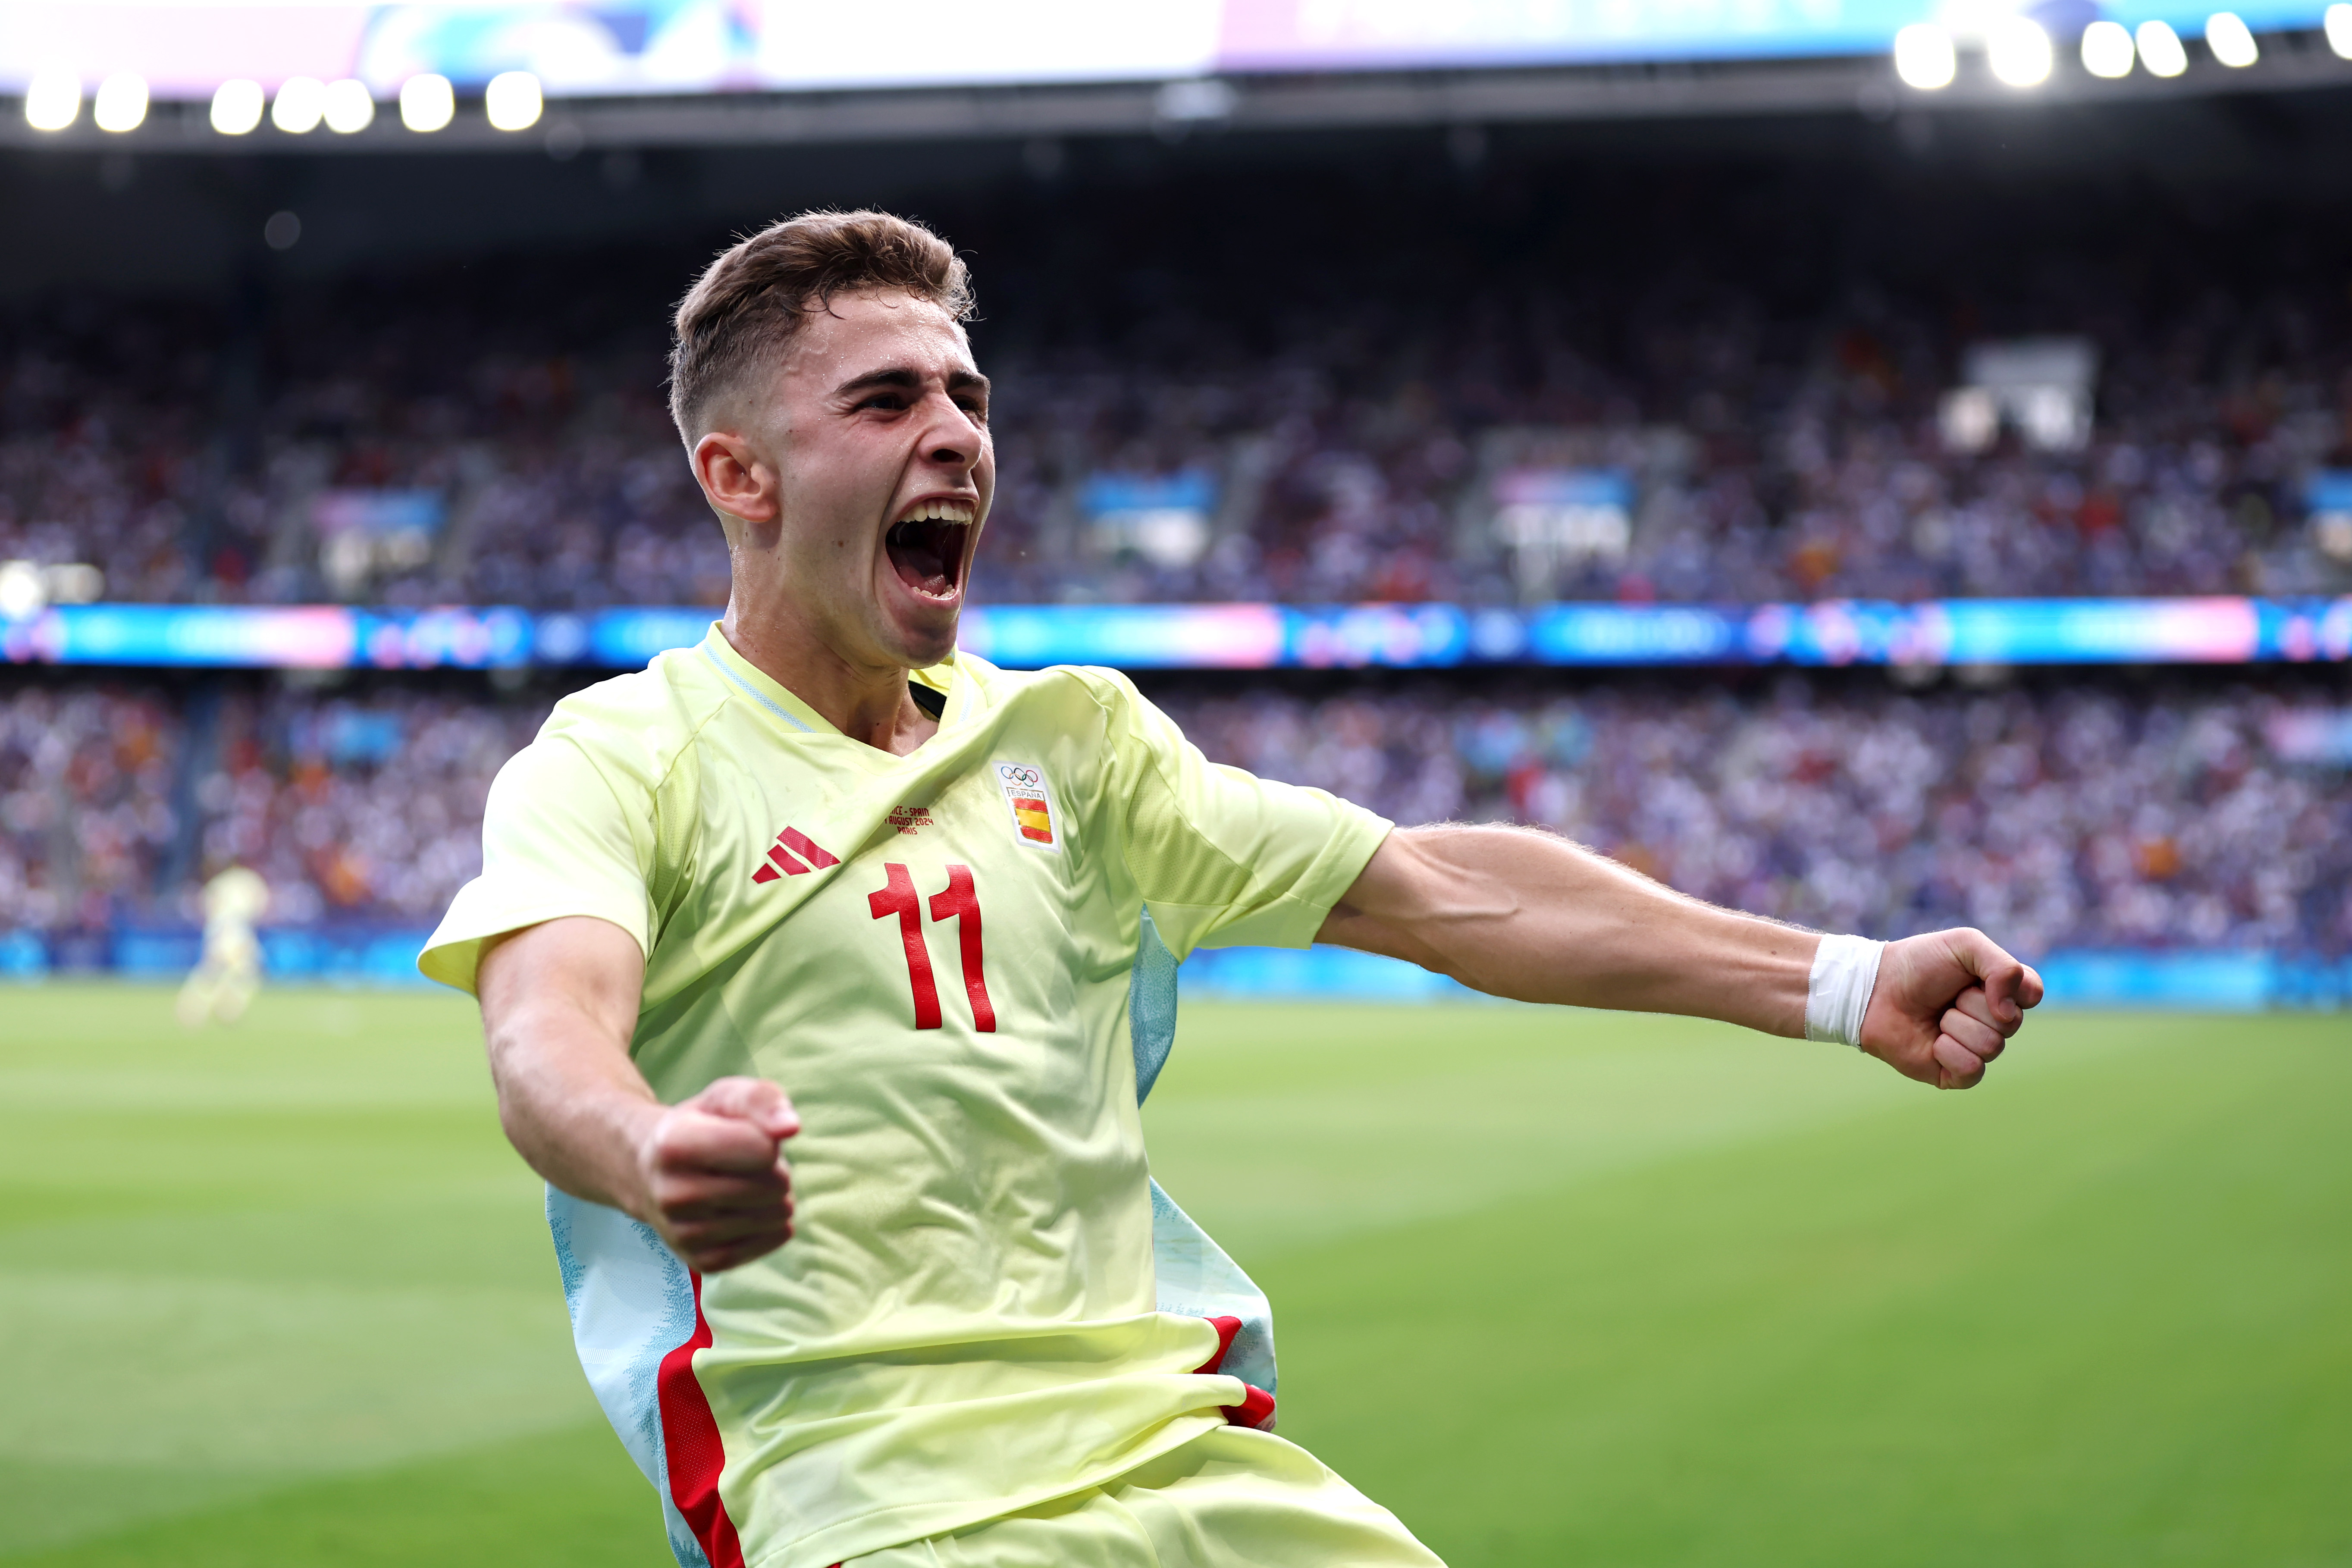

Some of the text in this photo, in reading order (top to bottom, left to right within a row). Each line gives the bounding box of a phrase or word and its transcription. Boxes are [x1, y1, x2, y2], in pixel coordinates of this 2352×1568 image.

[909, 808, 930, 816] SPAIN
[889, 815, 913, 826] AUGUST
[914, 818, 934, 826] 2024
[897, 826, 918, 835] PARIS
[868, 862, 996, 1032] 11
